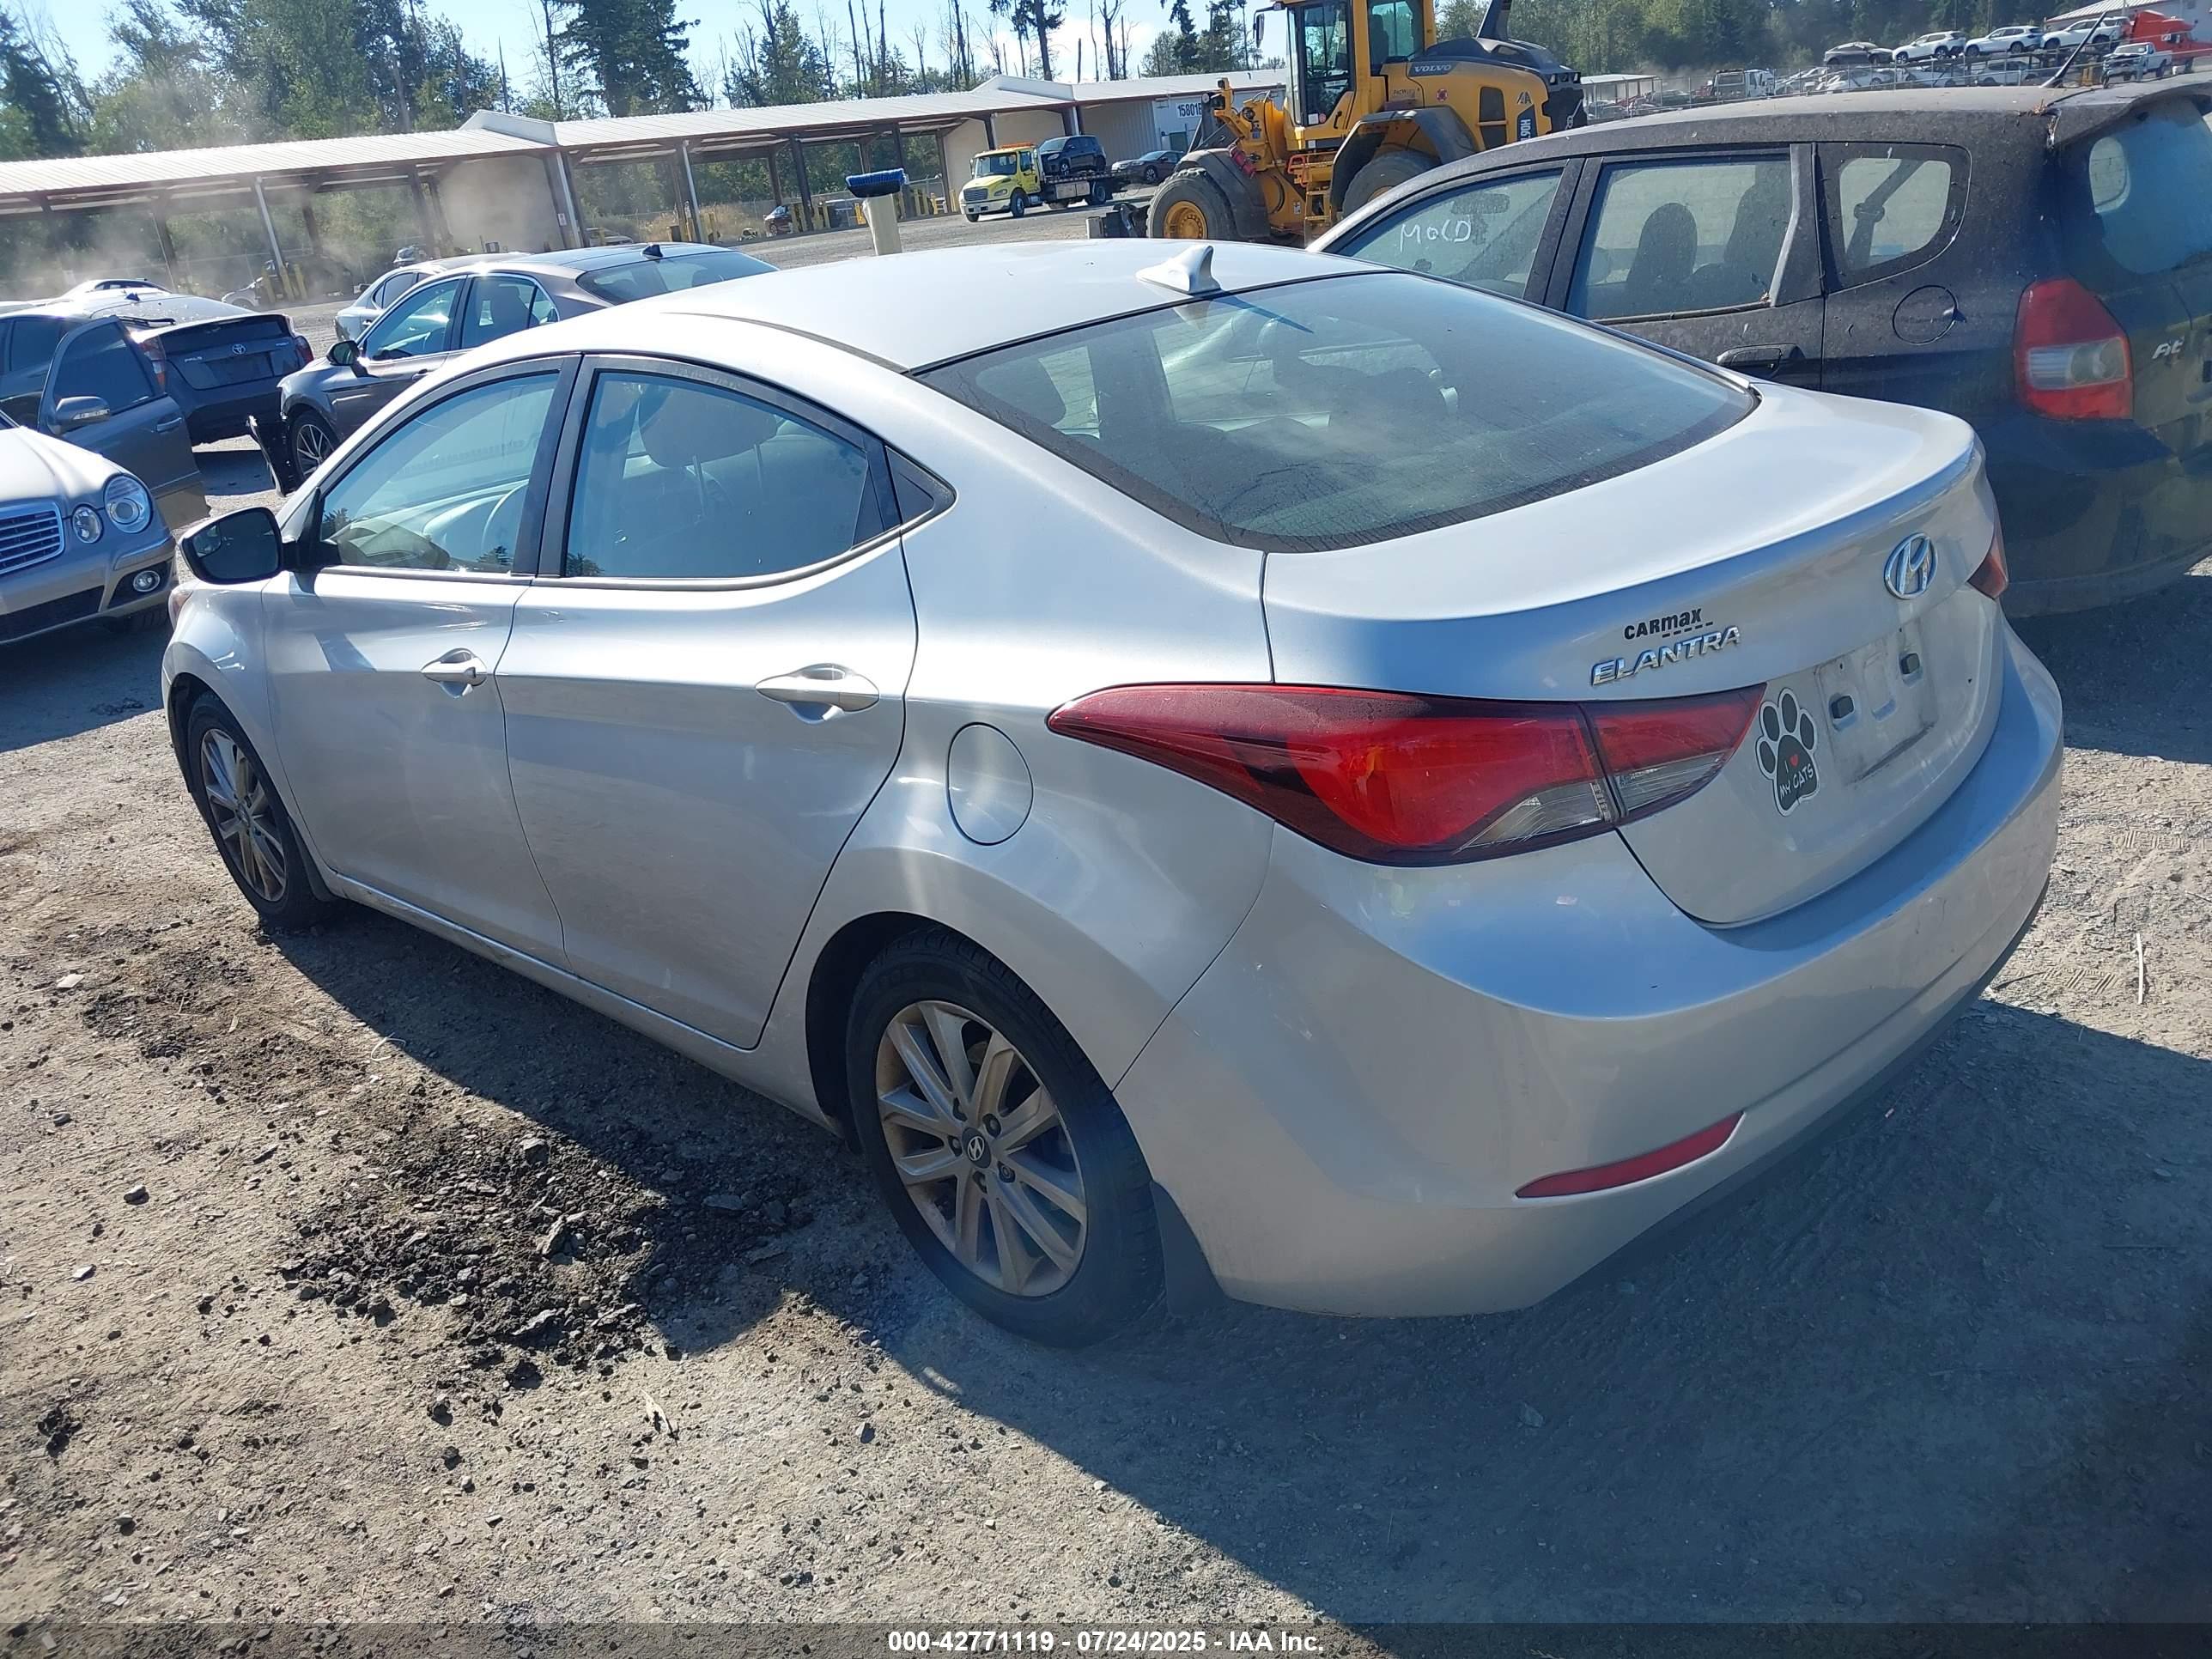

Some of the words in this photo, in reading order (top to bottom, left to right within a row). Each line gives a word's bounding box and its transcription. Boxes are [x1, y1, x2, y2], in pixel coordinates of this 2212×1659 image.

[1591, 625, 1741, 686] ELANTRA
[1779, 780, 1791, 800] MY
[1793, 763, 1814, 788] CATS
